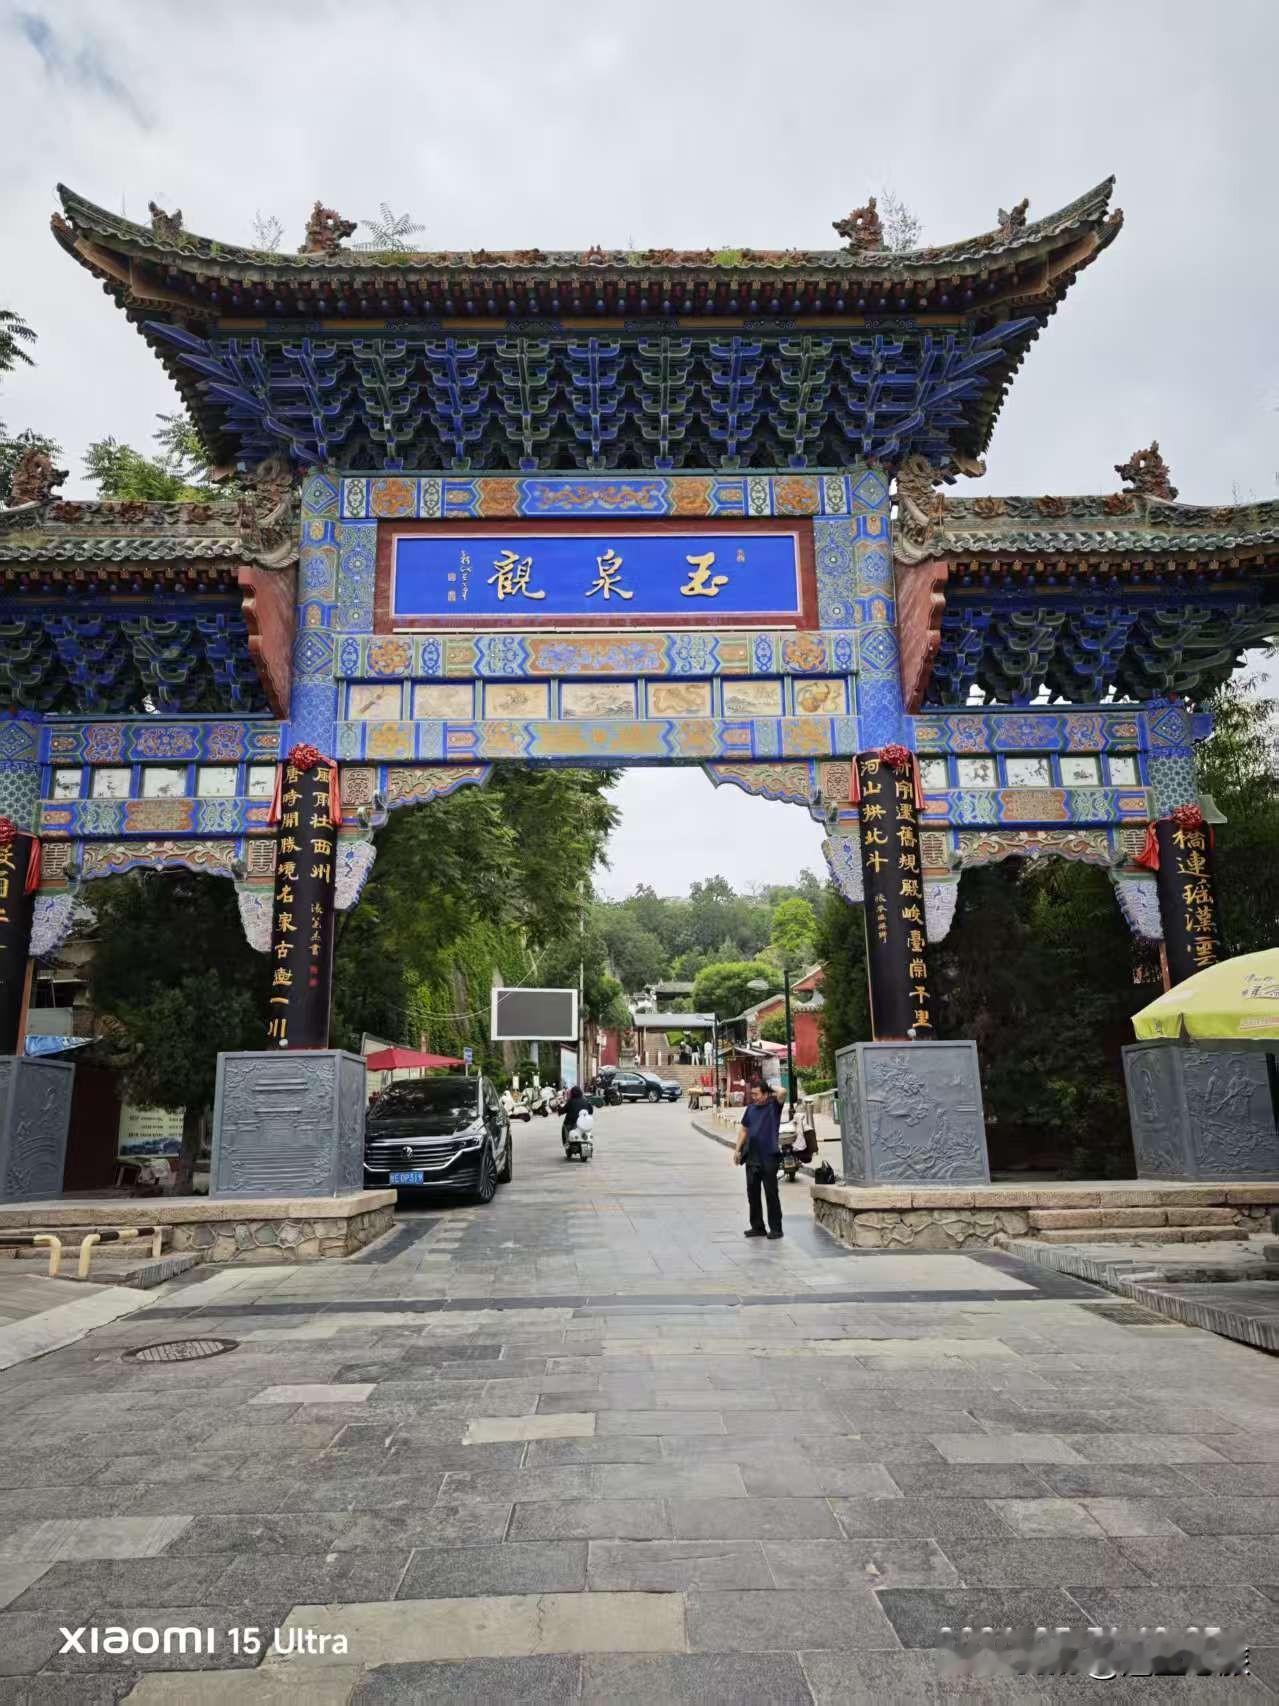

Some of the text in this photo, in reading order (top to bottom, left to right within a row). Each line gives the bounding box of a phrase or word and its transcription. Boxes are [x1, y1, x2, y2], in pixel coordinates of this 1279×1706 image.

[487, 549, 729, 601] 玉泉觀
[860, 759, 889, 873] 河山拱北斗
